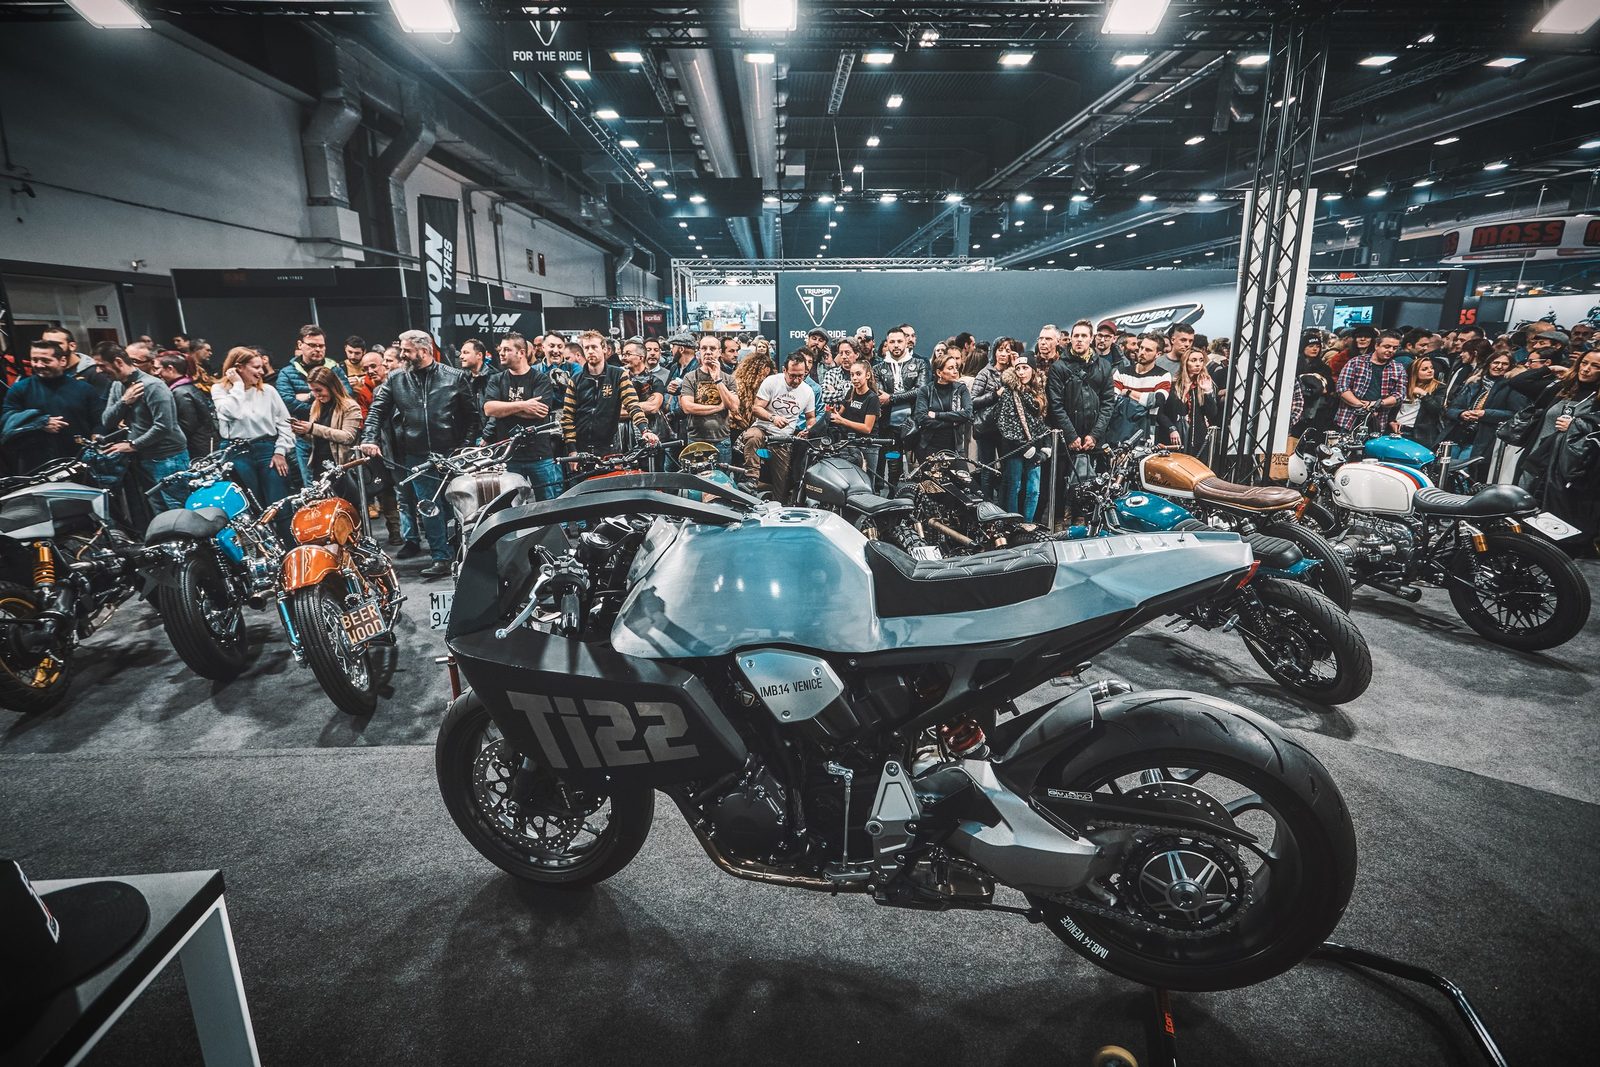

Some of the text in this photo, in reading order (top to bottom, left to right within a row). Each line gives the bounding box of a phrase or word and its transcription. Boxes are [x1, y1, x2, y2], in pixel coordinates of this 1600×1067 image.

[513, 51, 582, 61] FOR THE RIDE
[1473, 221, 1562, 246] MASS
[443, 238, 453, 290] TYRES
[425, 223, 443, 349] AVON
[1115, 308, 1177, 326] TRIUMPH
[342, 604, 379, 629] BEER
[347, 619, 384, 644] WOOD
[760, 678, 823, 698] IMB.14 VENICE
[506, 691, 699, 768] Ti22
[1060, 915, 1109, 959] IMB.14 VENICE
